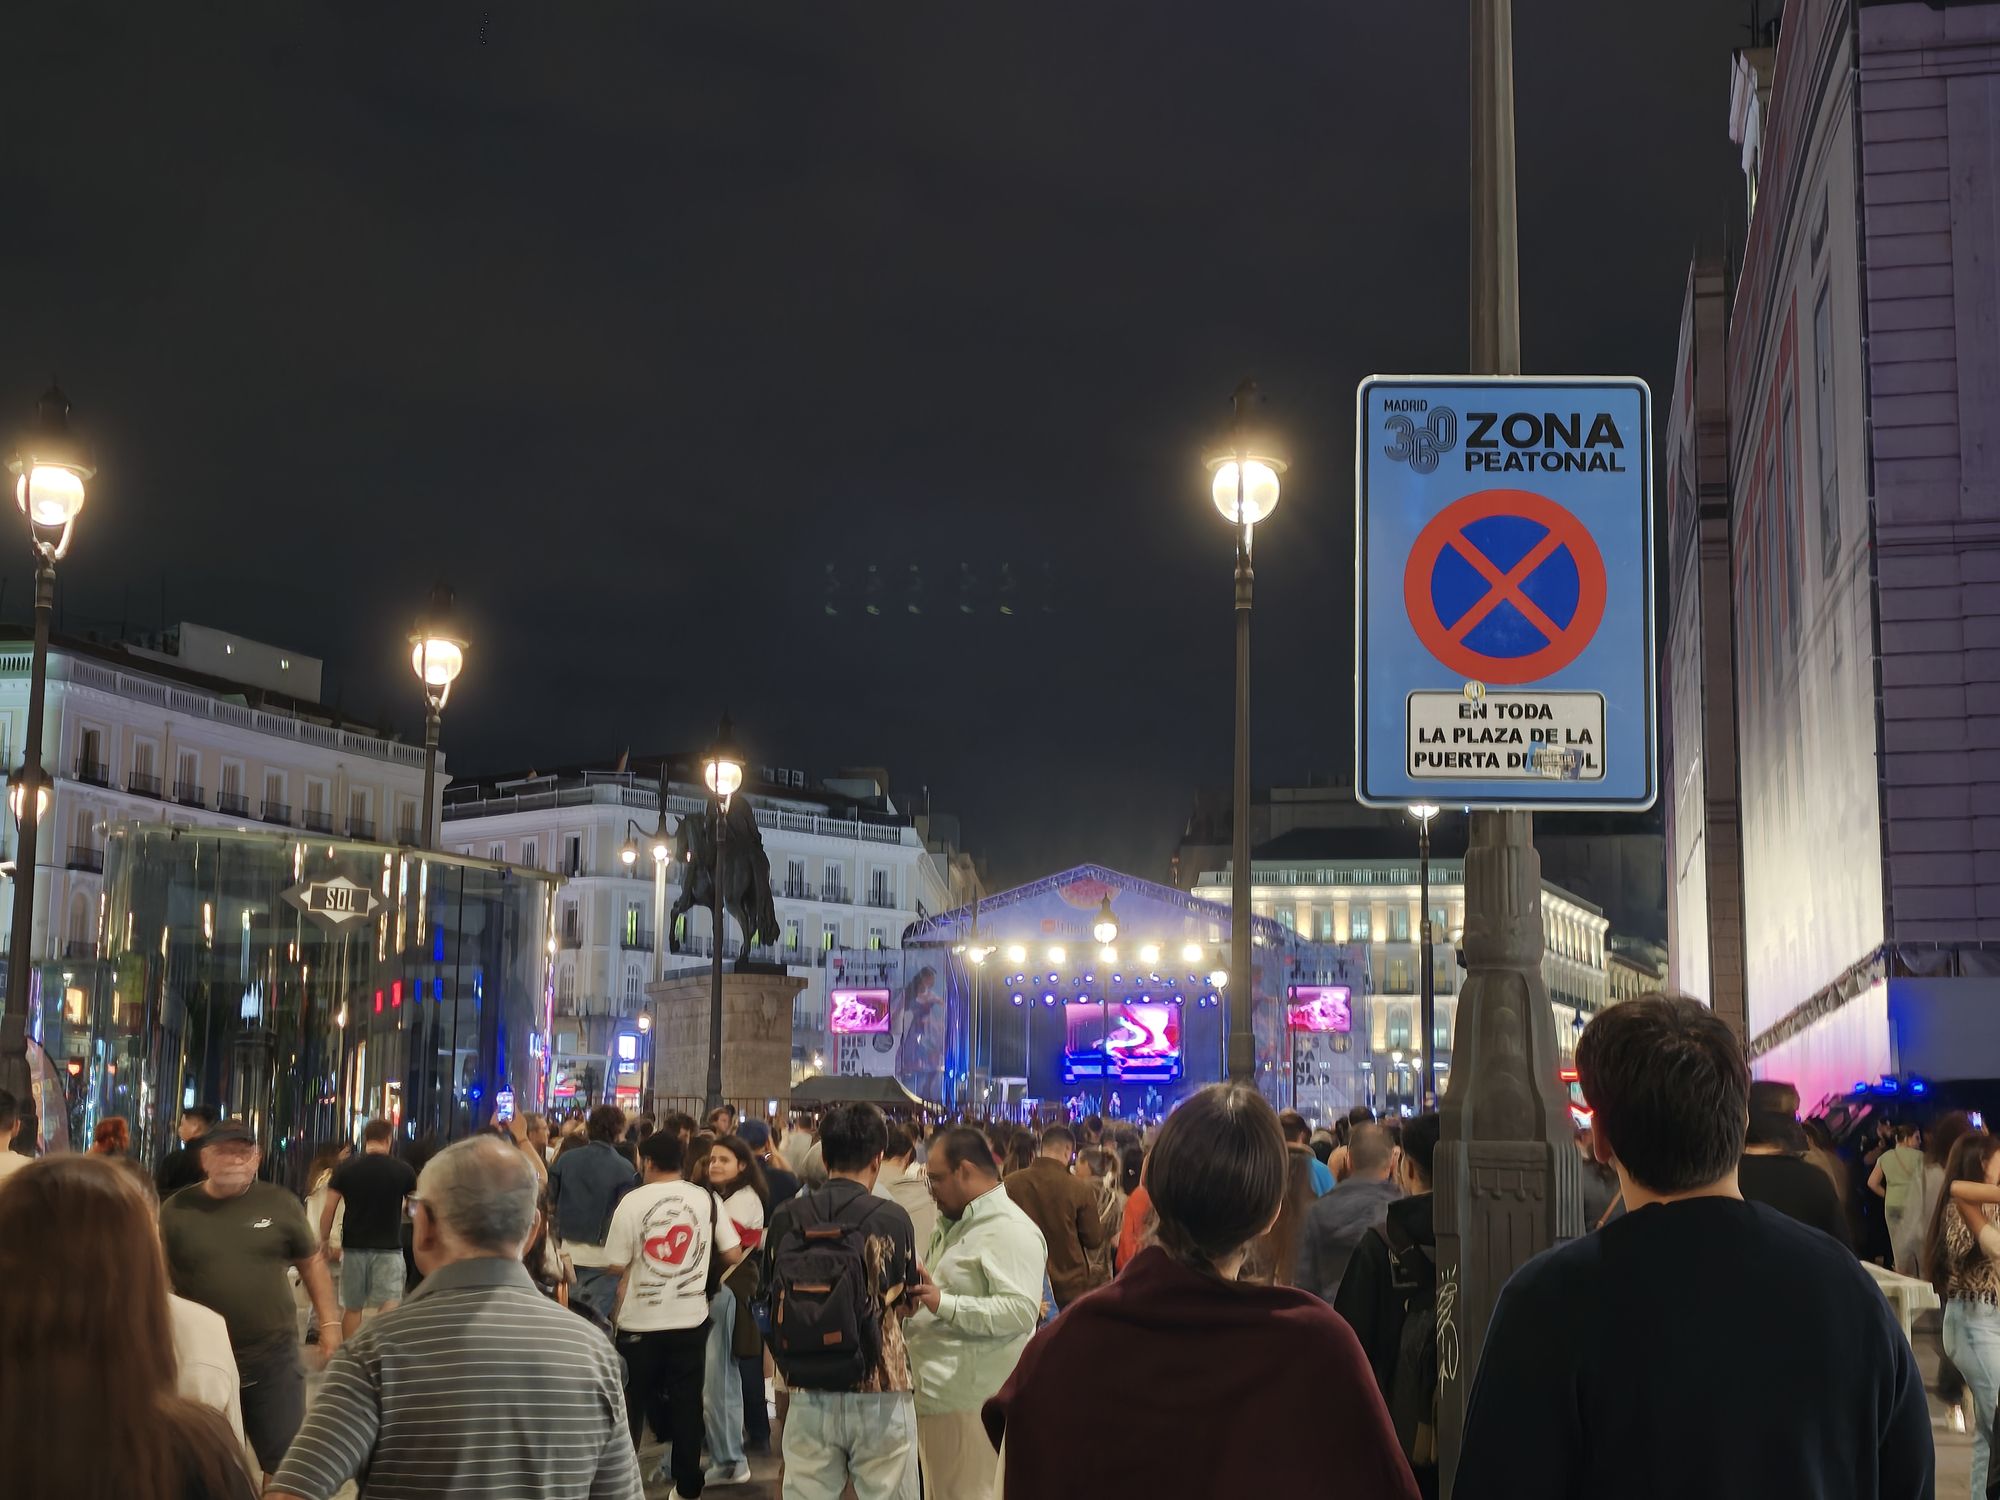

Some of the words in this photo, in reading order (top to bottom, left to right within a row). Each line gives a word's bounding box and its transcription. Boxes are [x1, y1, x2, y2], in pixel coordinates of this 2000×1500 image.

[1384, 400, 1428, 412] MADRID
[1466, 412, 1625, 449] ZONA
[1384, 406, 1458, 475] 360
[1464, 452, 1626, 473] PEATONAL
[1458, 703, 1488, 719] EN
[1495, 703, 1553, 719] TODA
[1419, 728, 1447, 744] LA
[1453, 728, 1524, 744] PLAZA
[1530, 728, 1559, 744] DE
[1565, 728, 1594, 744] LA
[1414, 751, 1500, 769] PUERTA
[325, 887, 355, 912] SOL
[841, 1048, 860, 1060] PA
[841, 1061, 856, 1072] NI
